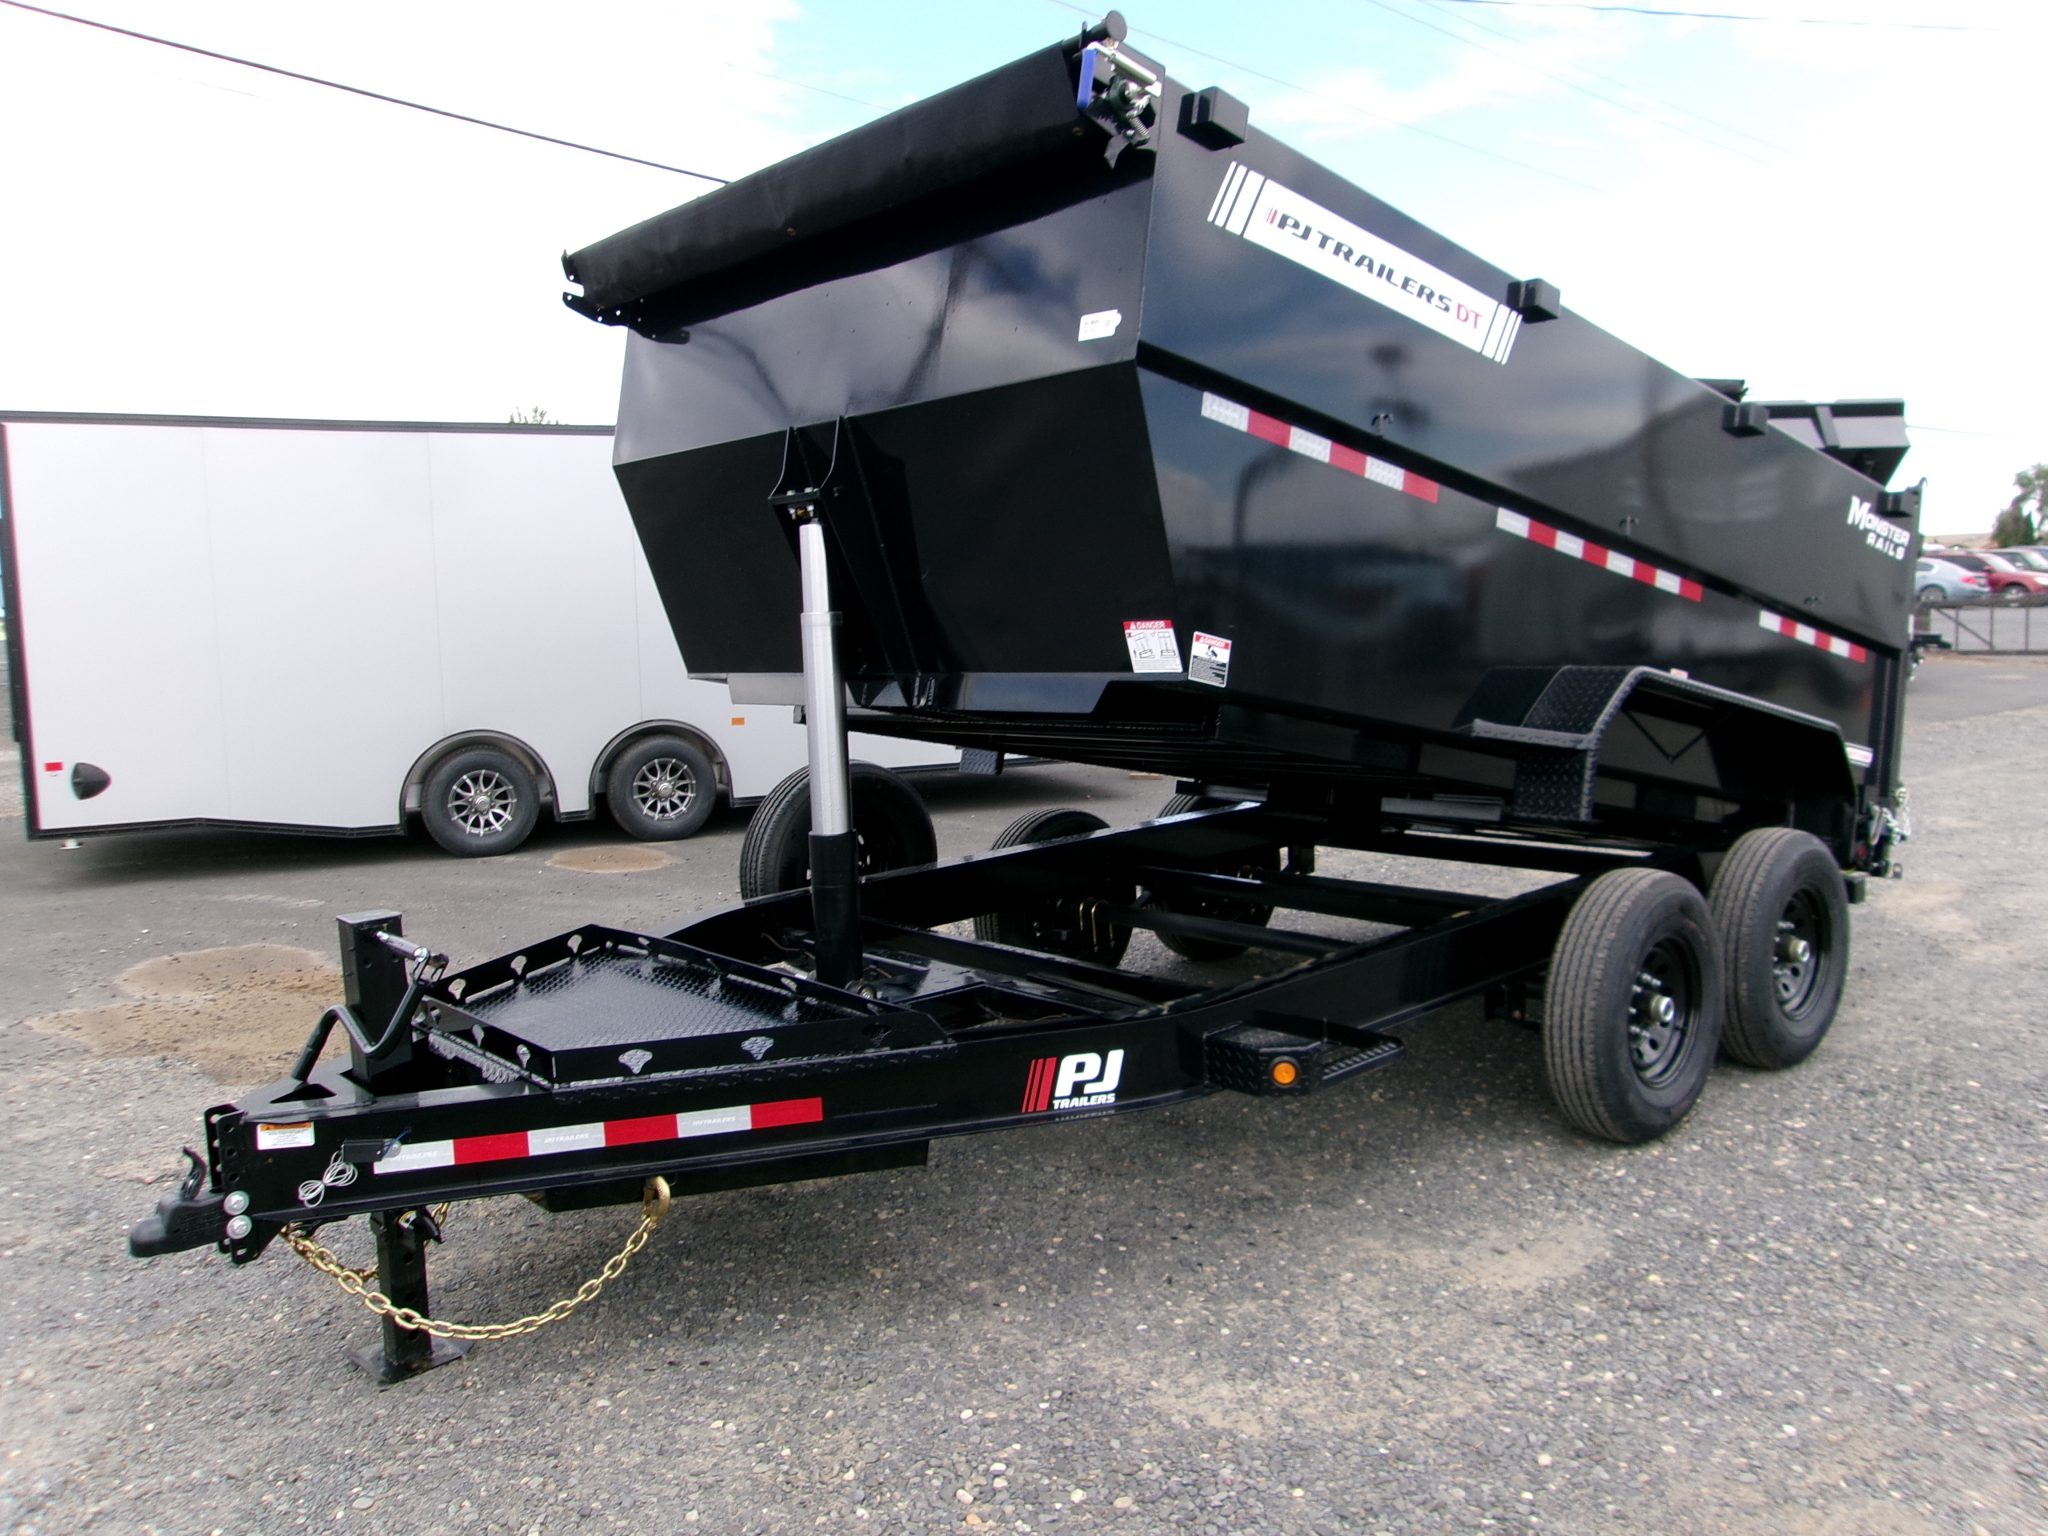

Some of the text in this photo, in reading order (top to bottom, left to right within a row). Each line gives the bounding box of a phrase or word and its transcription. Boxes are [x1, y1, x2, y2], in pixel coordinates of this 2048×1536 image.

[1277, 213, 1484, 329] PJ TRAILERS DT
[1866, 532, 1906, 561] RAILS
[1136, 620, 1166, 630] DANGER
[1054, 1048, 1125, 1098] PJ
[1052, 1093, 1116, 1110] TRAILERS
